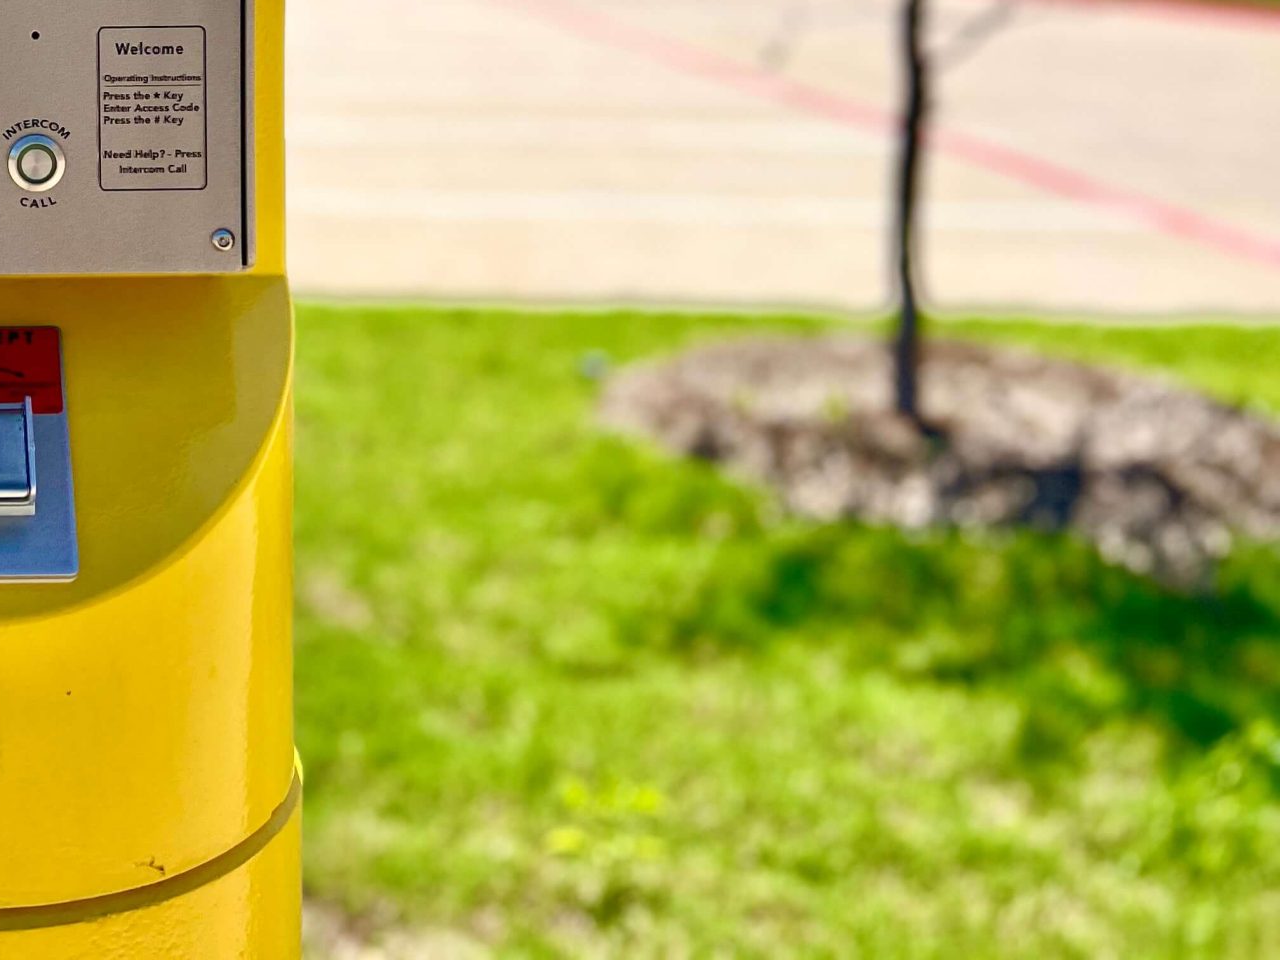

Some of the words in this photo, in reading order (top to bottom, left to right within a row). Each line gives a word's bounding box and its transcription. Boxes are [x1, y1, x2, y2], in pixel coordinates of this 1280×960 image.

[115, 41, 184, 56] Welcome
[104, 74, 149, 83] Operating
[151, 73, 202, 82] Instructions
[103, 92, 131, 100] Press
[133, 91, 151, 100] the
[163, 91, 184, 102] Key
[103, 104, 131, 113] Enter
[134, 104, 170, 112] Access
[172, 103, 200, 112] Code
[103, 116, 131, 125] Press
[133, 115, 151, 124] the
[163, 115, 184, 126] Key
[2, 119, 71, 140] INTERCOM
[103, 150, 132, 159] Need
[134, 149, 166, 160] Help?
[174, 149, 202, 158] Press
[119, 165, 165, 174] Intercom
[168, 164, 187, 173] Call
[20, 197, 57, 208] CALL
